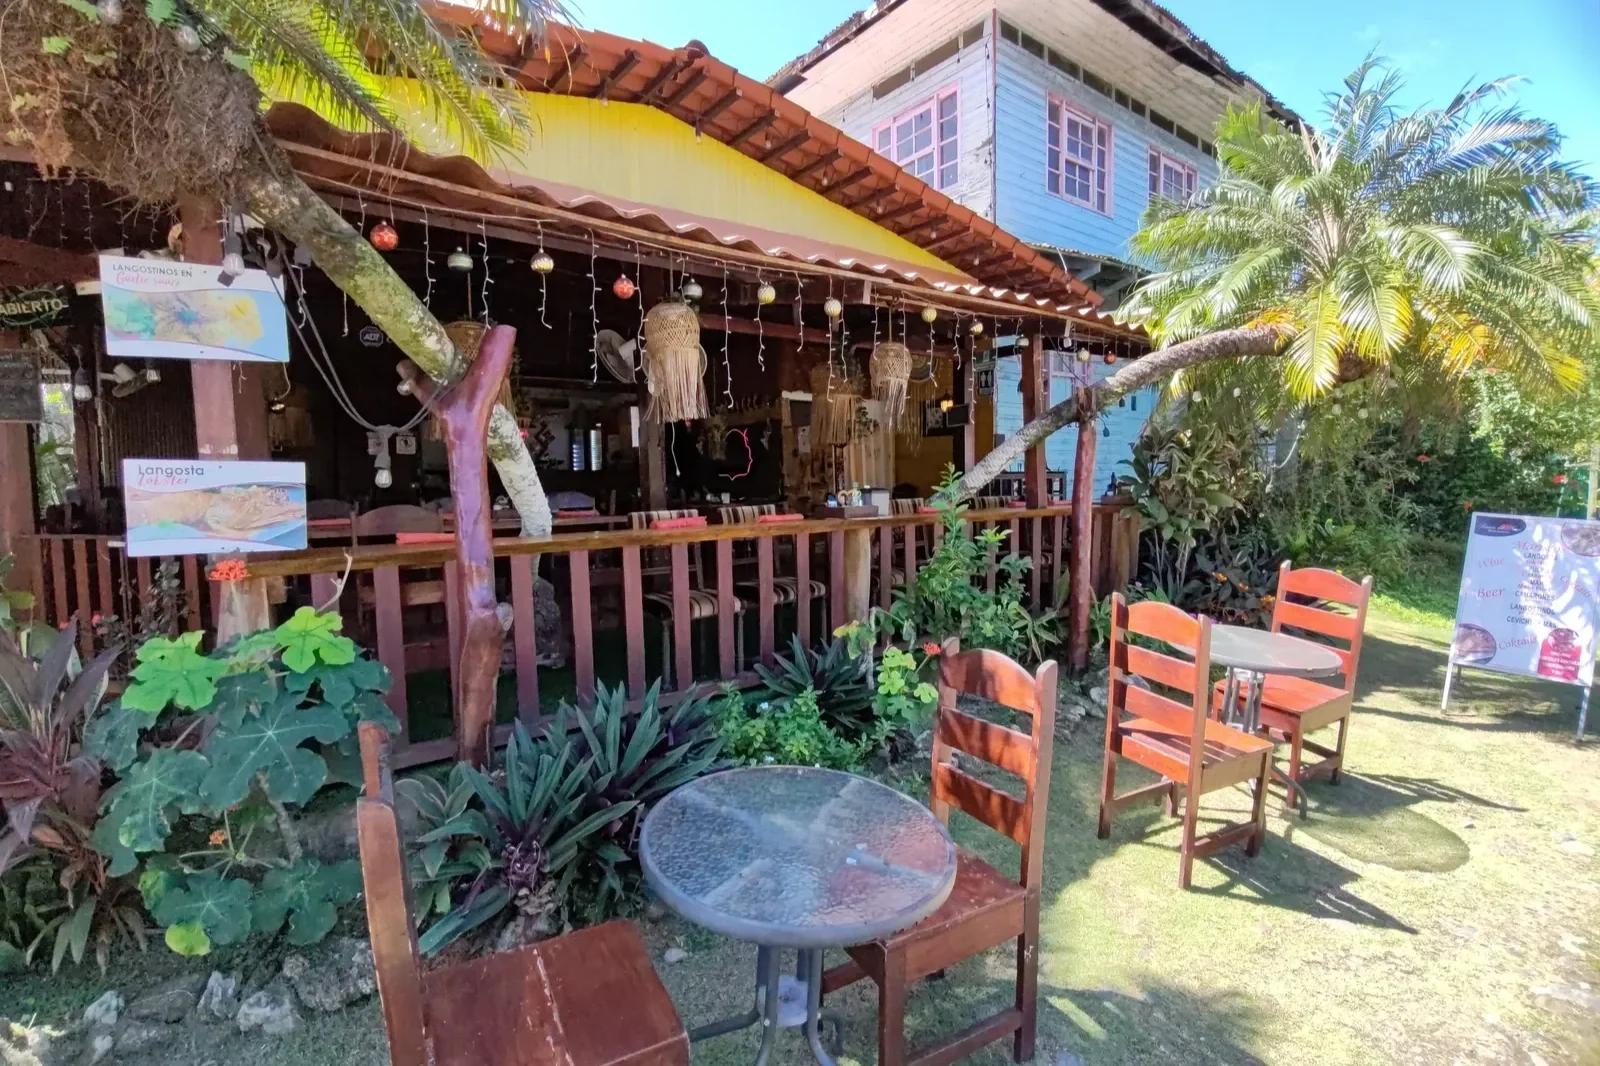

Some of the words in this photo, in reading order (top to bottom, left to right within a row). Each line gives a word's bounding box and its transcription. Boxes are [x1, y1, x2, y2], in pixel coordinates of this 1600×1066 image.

[112, 263, 178, 276] LANGOSTINOS
[181, 269, 193, 277] EN
[0, 297, 63, 316] ABIERTO
[363, 333, 380, 341] ADT
[138, 464, 204, 478] Langosta
[1477, 587, 1506, 597] Beer
